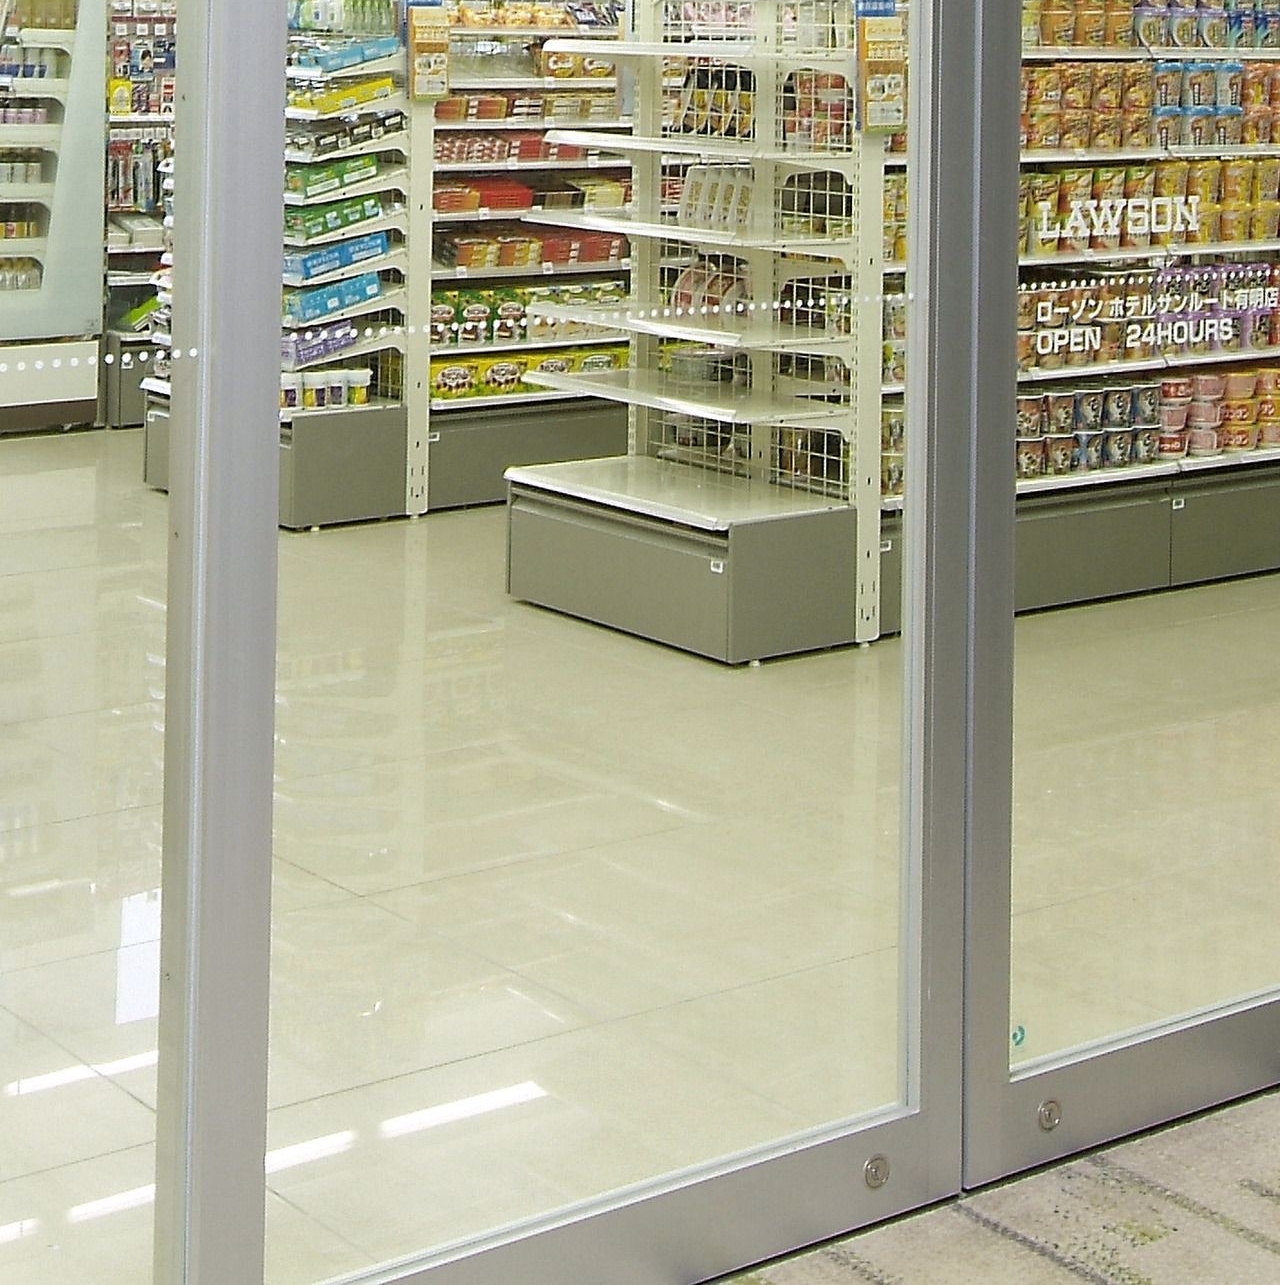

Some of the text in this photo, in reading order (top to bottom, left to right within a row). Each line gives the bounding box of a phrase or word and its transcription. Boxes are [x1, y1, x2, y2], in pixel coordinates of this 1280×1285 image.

[1037, 195, 1200, 239] LAWSON
[1036, 318, 1234, 355] OPEN 24HOURS
